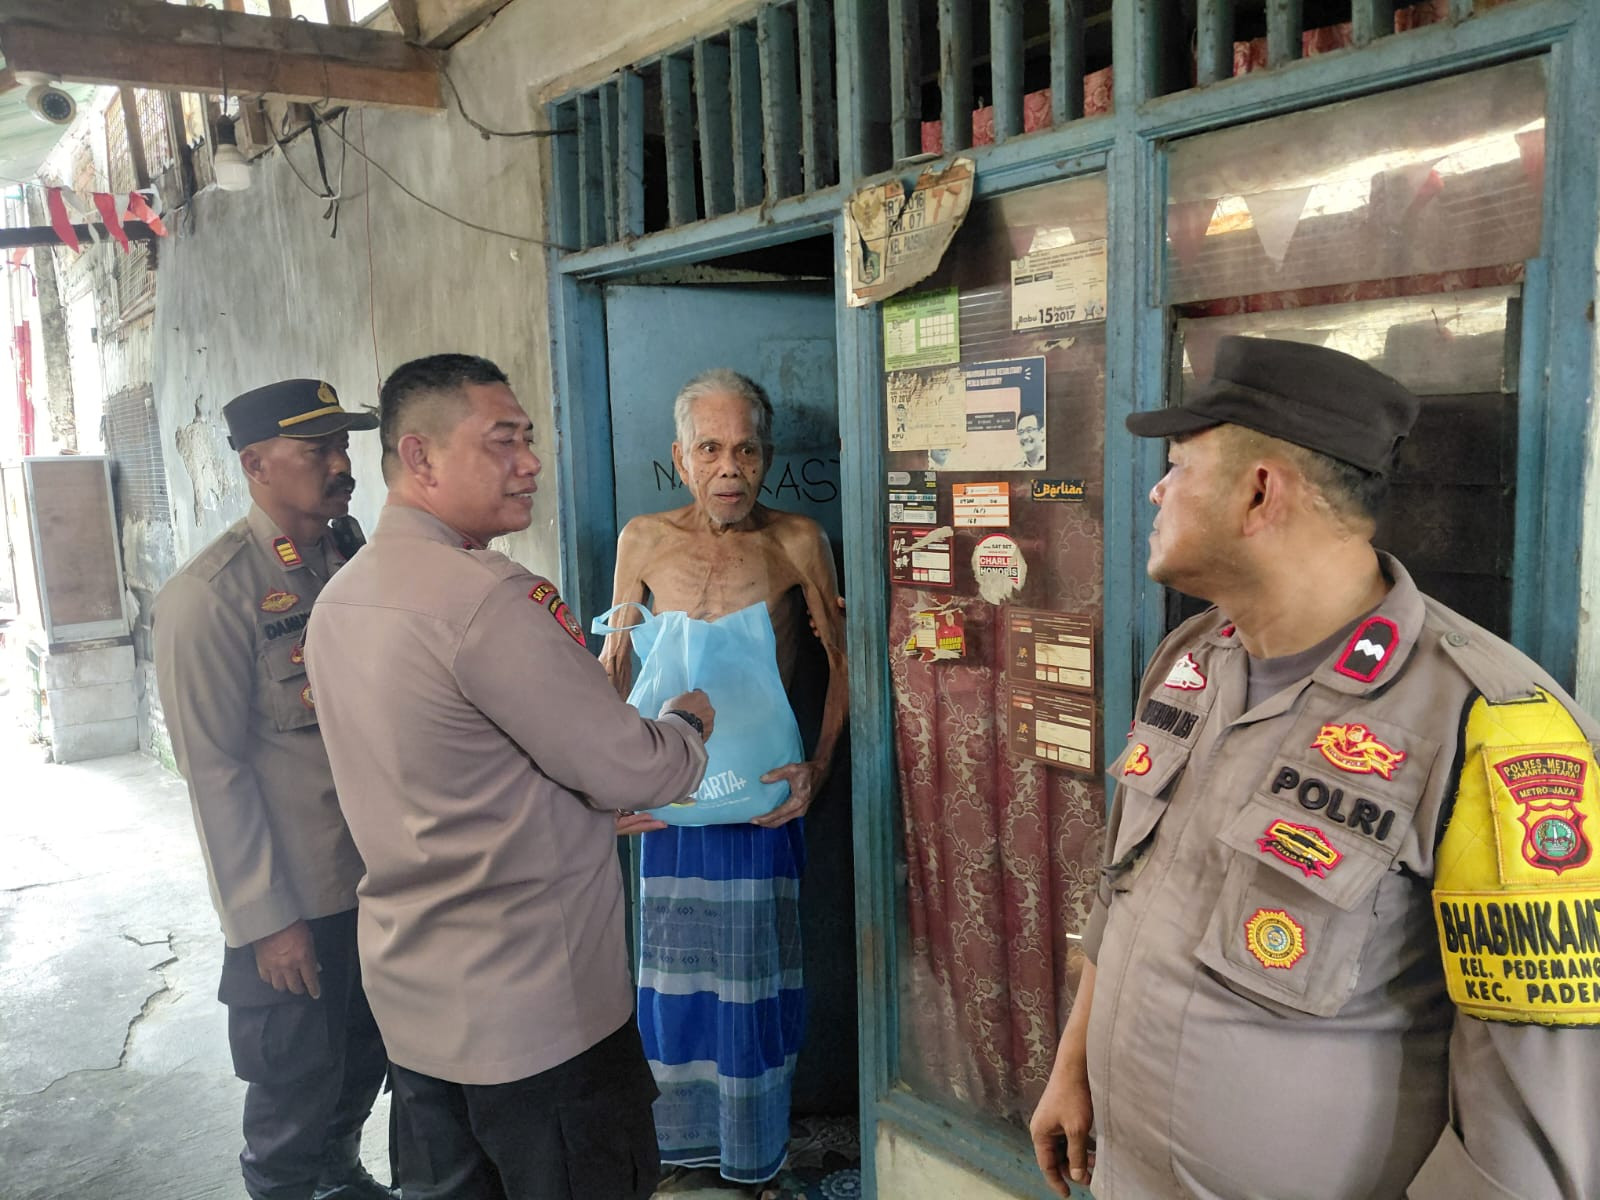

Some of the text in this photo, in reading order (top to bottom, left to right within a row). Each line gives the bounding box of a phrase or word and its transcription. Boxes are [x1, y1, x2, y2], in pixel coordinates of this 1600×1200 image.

[1018, 314, 1037, 323] Rabu
[1039, 307, 1053, 324] 15
[1054, 310, 1076, 323] 2017
[1503, 758, 1581, 777] POLRES METRO
[1519, 786, 1576, 798] METRO JAYA
[1271, 766, 1396, 841] POLRI
[1459, 957, 1494, 979] KEL.
[1465, 980, 1512, 1003] KEC.
